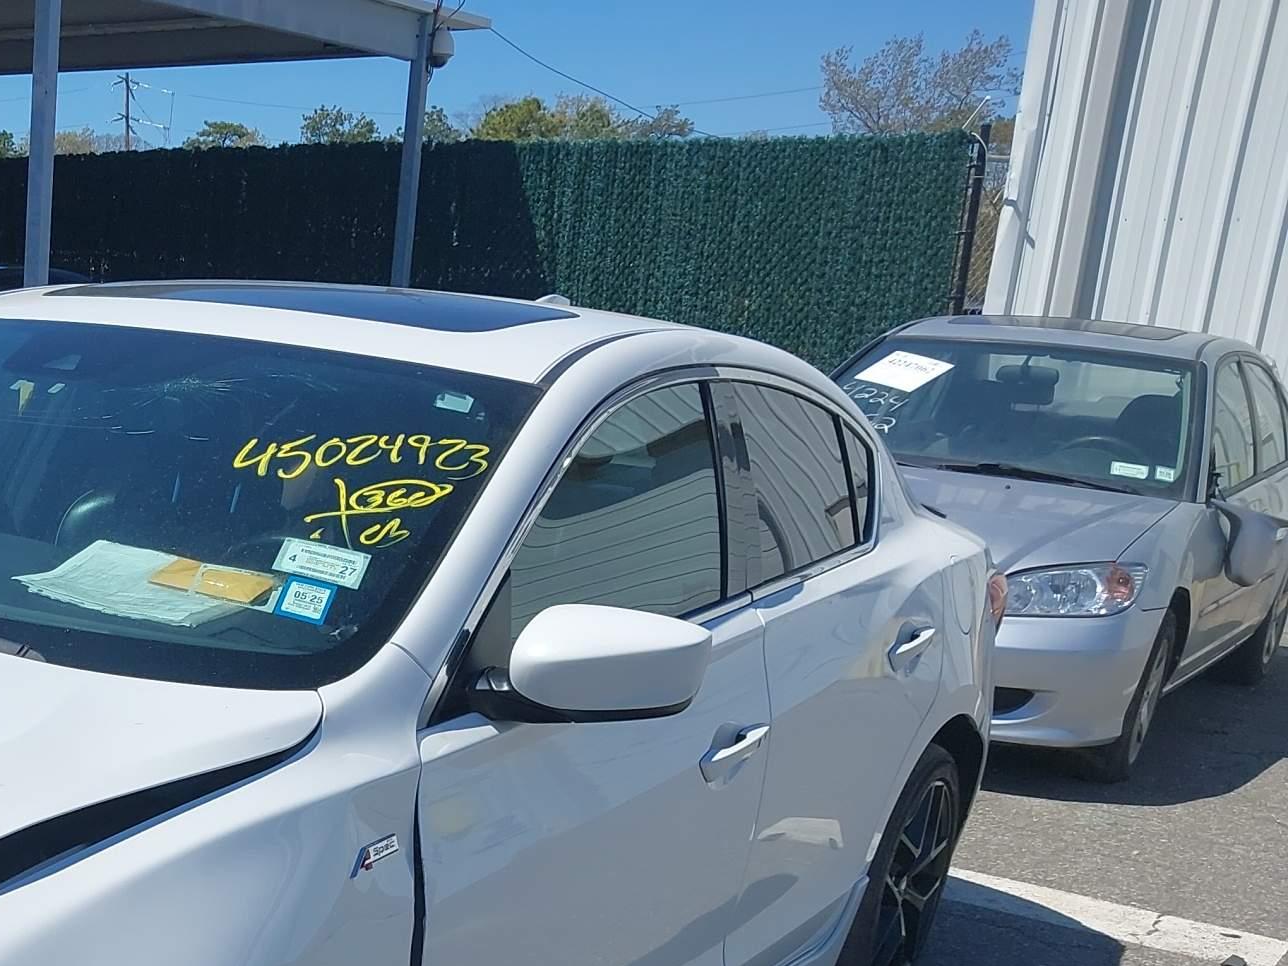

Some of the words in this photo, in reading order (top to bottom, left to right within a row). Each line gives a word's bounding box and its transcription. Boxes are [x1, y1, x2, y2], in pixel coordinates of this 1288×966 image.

[232, 434, 490, 480] 45024923
[288, 554, 298, 563] 4
[338, 565, 358, 577] 27
[294, 590, 308, 601] 05
[309, 594, 323, 605] 25
